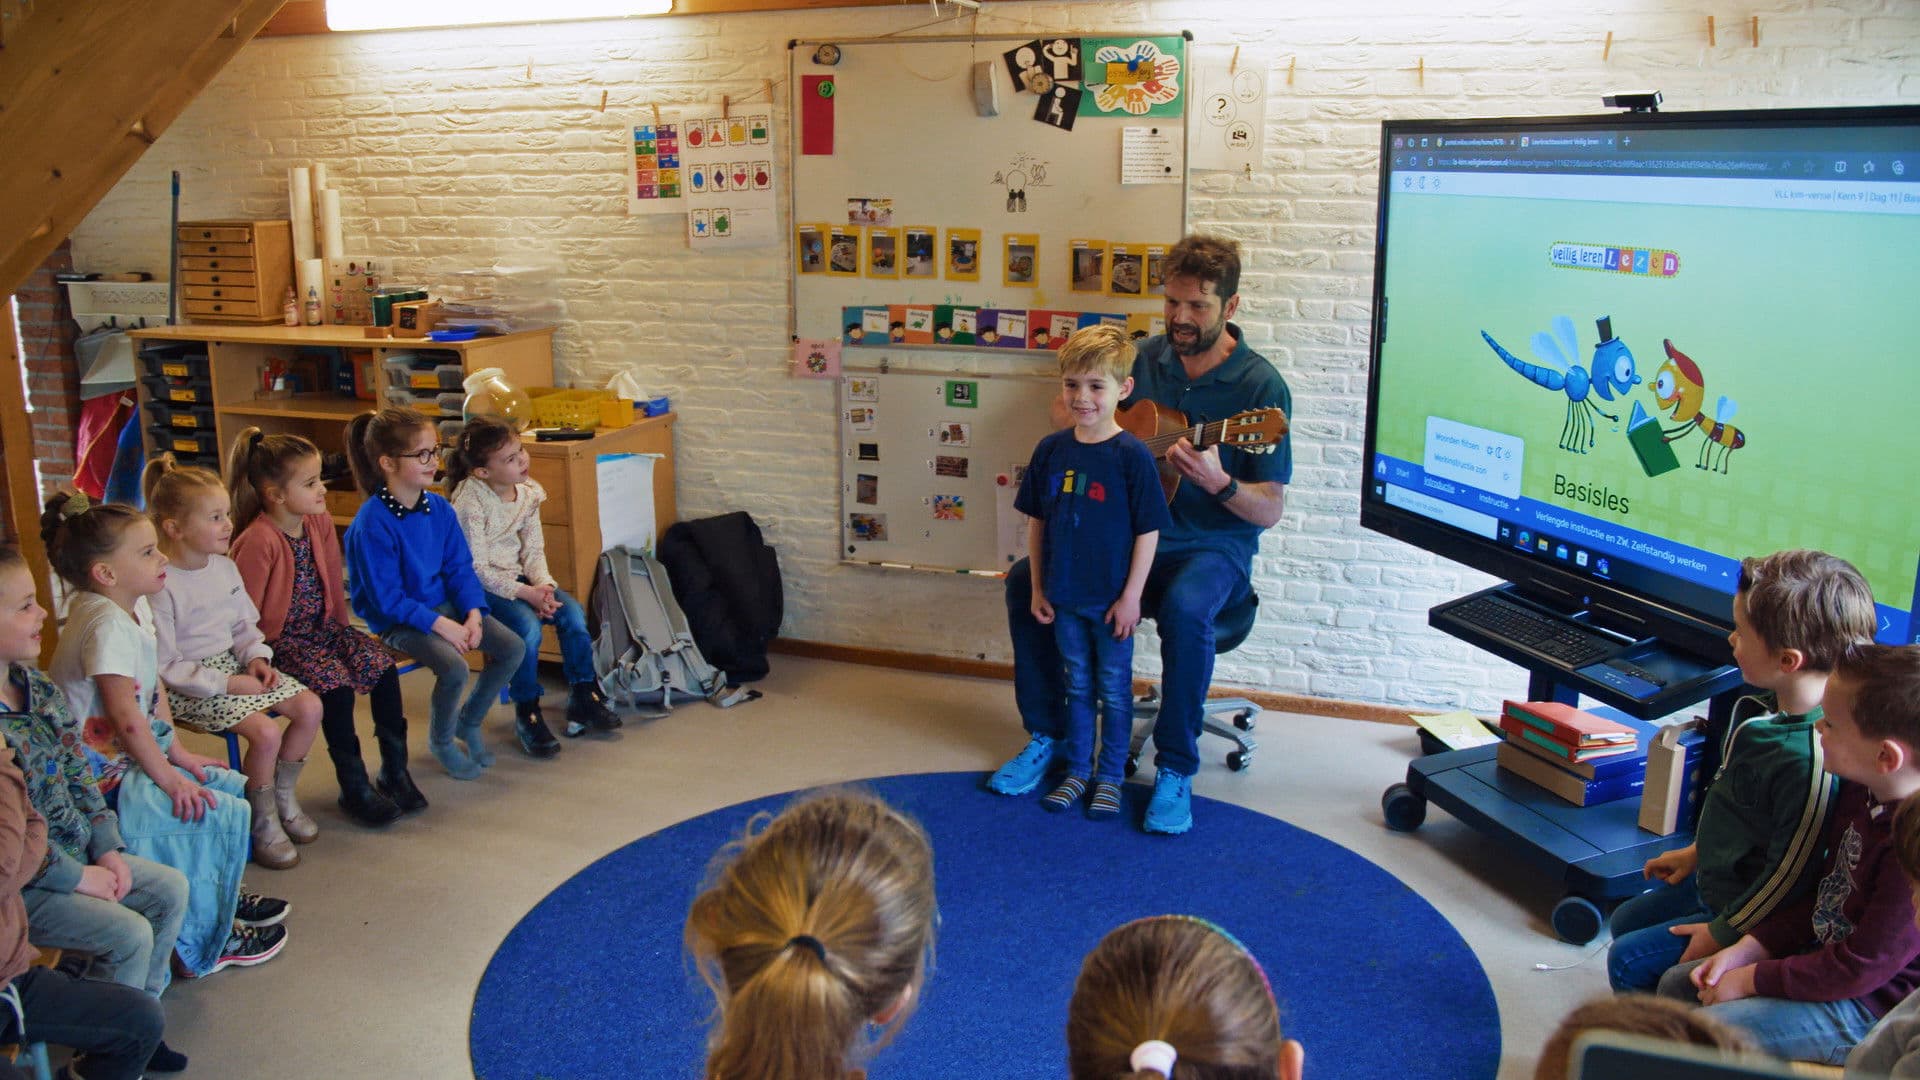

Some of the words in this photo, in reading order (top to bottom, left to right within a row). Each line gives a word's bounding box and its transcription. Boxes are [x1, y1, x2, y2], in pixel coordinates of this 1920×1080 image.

[1552, 246, 1577, 264] veilig
[1580, 248, 1603, 263] leren
[1606, 249, 1676, 271] Lezen
[1478, 493, 1510, 510] Instructie
[1554, 474, 1630, 515] Basisles
[1535, 510, 1570, 530] Verlengde
[1569, 522, 1605, 540] instructie
[1605, 534, 1616, 544] en
[1631, 536, 1675, 564] Zelfstandig
[1676, 556, 1708, 573] werken
